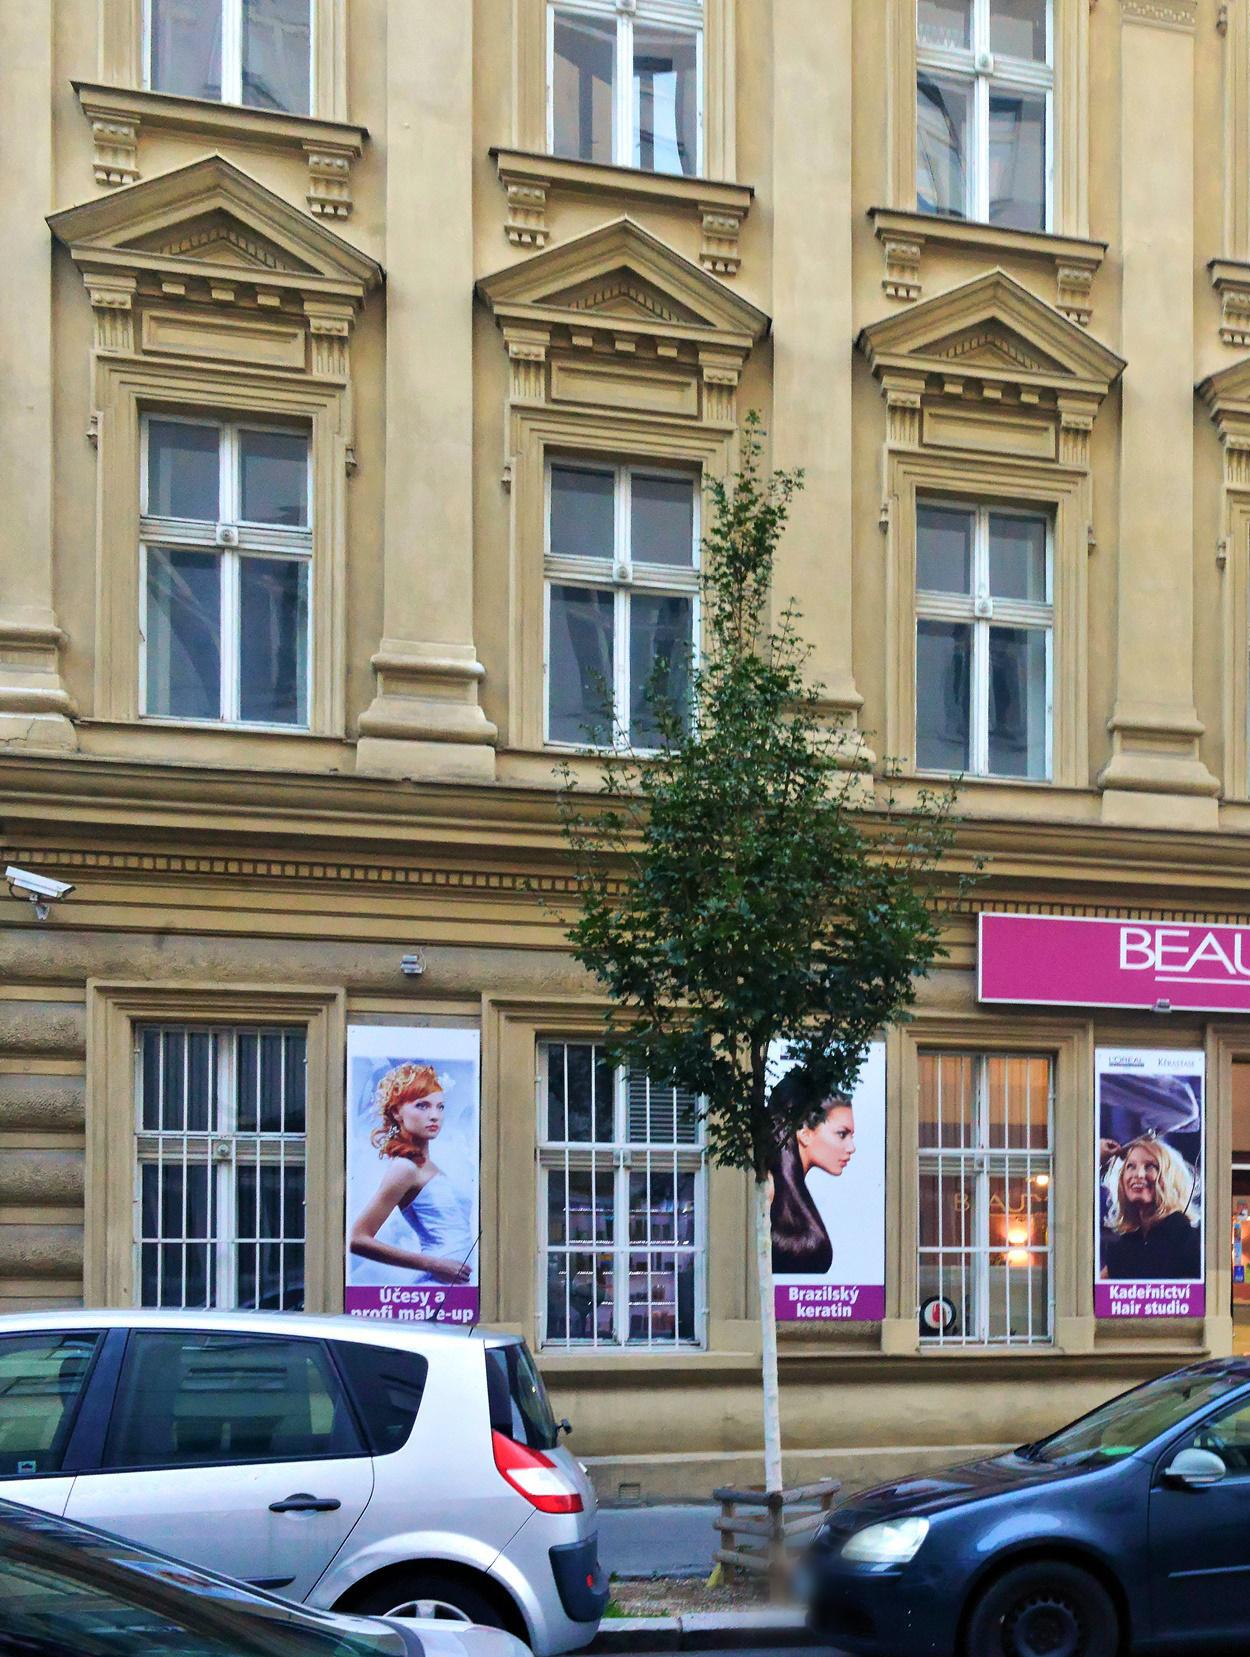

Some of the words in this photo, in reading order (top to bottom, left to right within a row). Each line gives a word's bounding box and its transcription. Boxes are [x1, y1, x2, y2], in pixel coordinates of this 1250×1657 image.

[380, 1286, 430, 1307] Účesy
[434, 1291, 446, 1303] a
[788, 1286, 860, 1305] Brazilský
[1109, 1283, 1191, 1300] Kadeřnictví
[796, 1302, 852, 1318] keratin
[1111, 1300, 1142, 1315] Hair
[1144, 1300, 1190, 1315] studio
